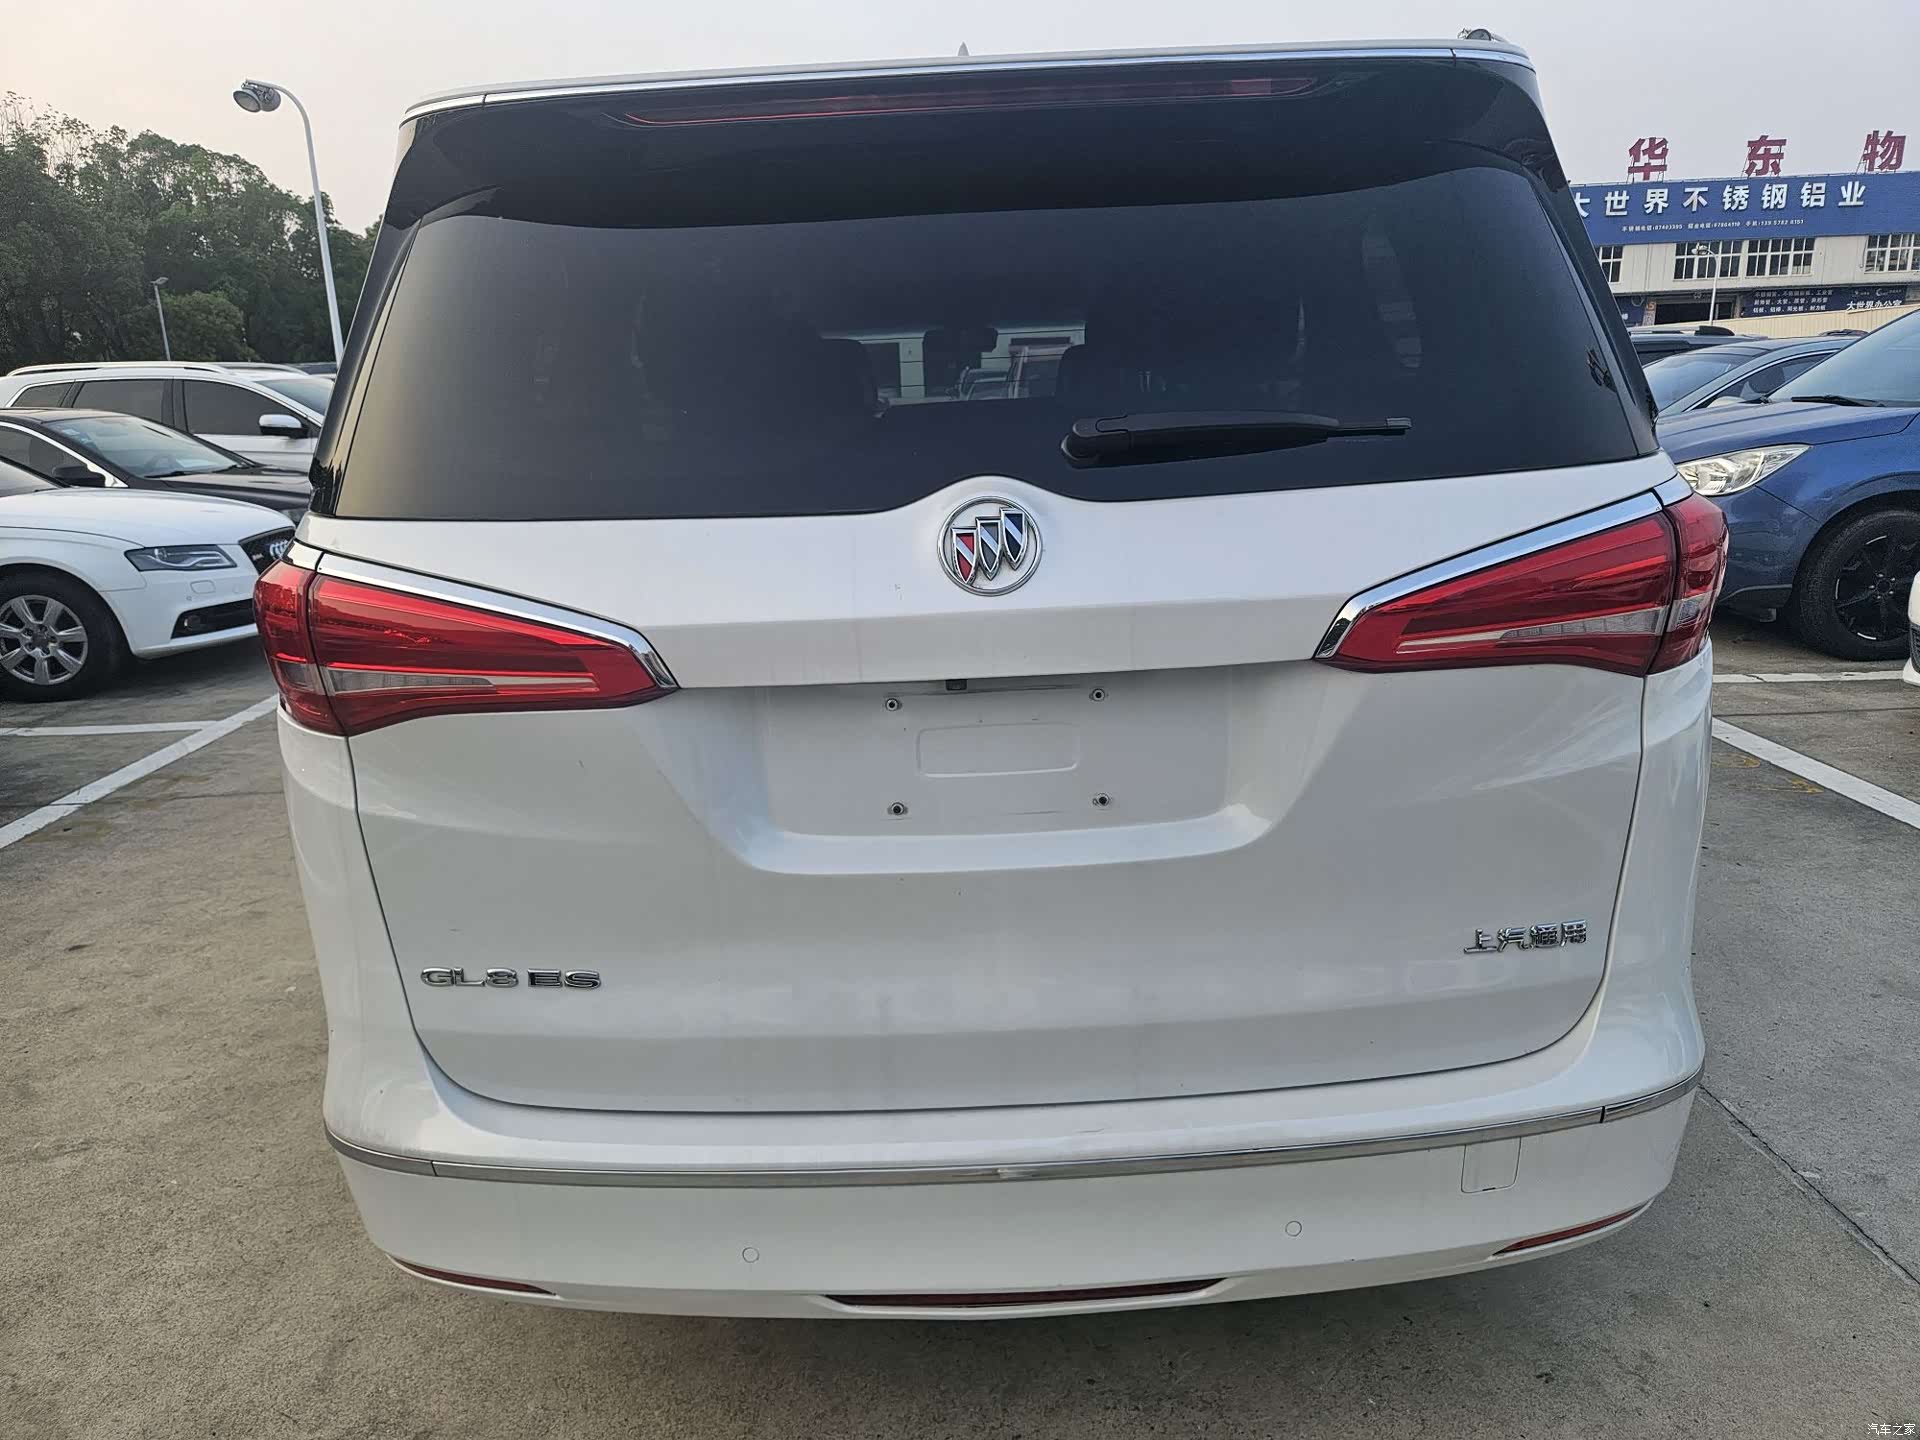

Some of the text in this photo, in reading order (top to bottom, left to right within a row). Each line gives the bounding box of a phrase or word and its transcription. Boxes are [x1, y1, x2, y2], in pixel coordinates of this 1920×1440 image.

[1627, 130, 1906, 181] 华东物
[1572, 180, 1867, 219] 大世界不锈钢铝业
[1464, 919, 1587, 954] 上汽通用
[420, 967, 602, 989] GL8 ES
